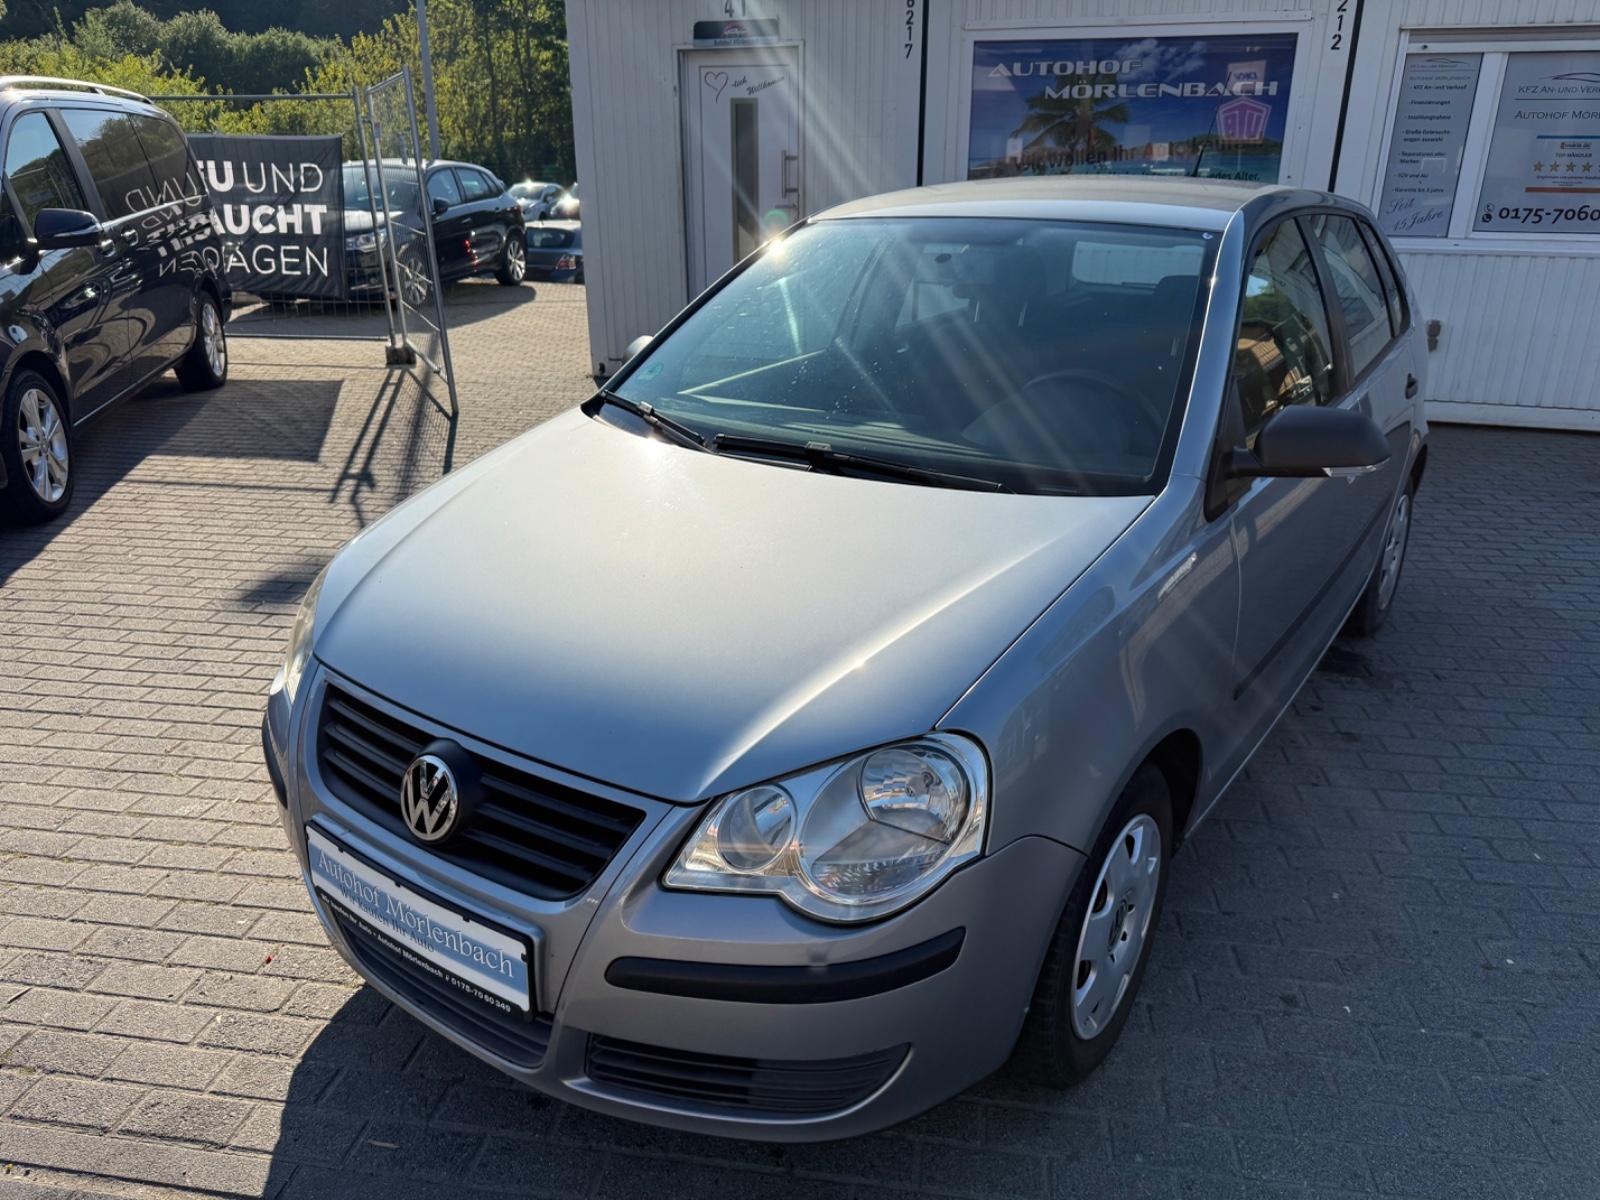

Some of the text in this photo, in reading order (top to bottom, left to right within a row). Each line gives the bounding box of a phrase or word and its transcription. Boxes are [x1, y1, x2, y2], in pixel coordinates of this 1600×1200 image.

[988, 60, 1144, 77] AUTOHOF
[1045, 80, 1278, 100] MÖRLENBACH
[1514, 110, 1569, 120] AUTOHOF
[242, 161, 324, 194] UND
[318, 848, 515, 979] Autohof Mörlenbach
